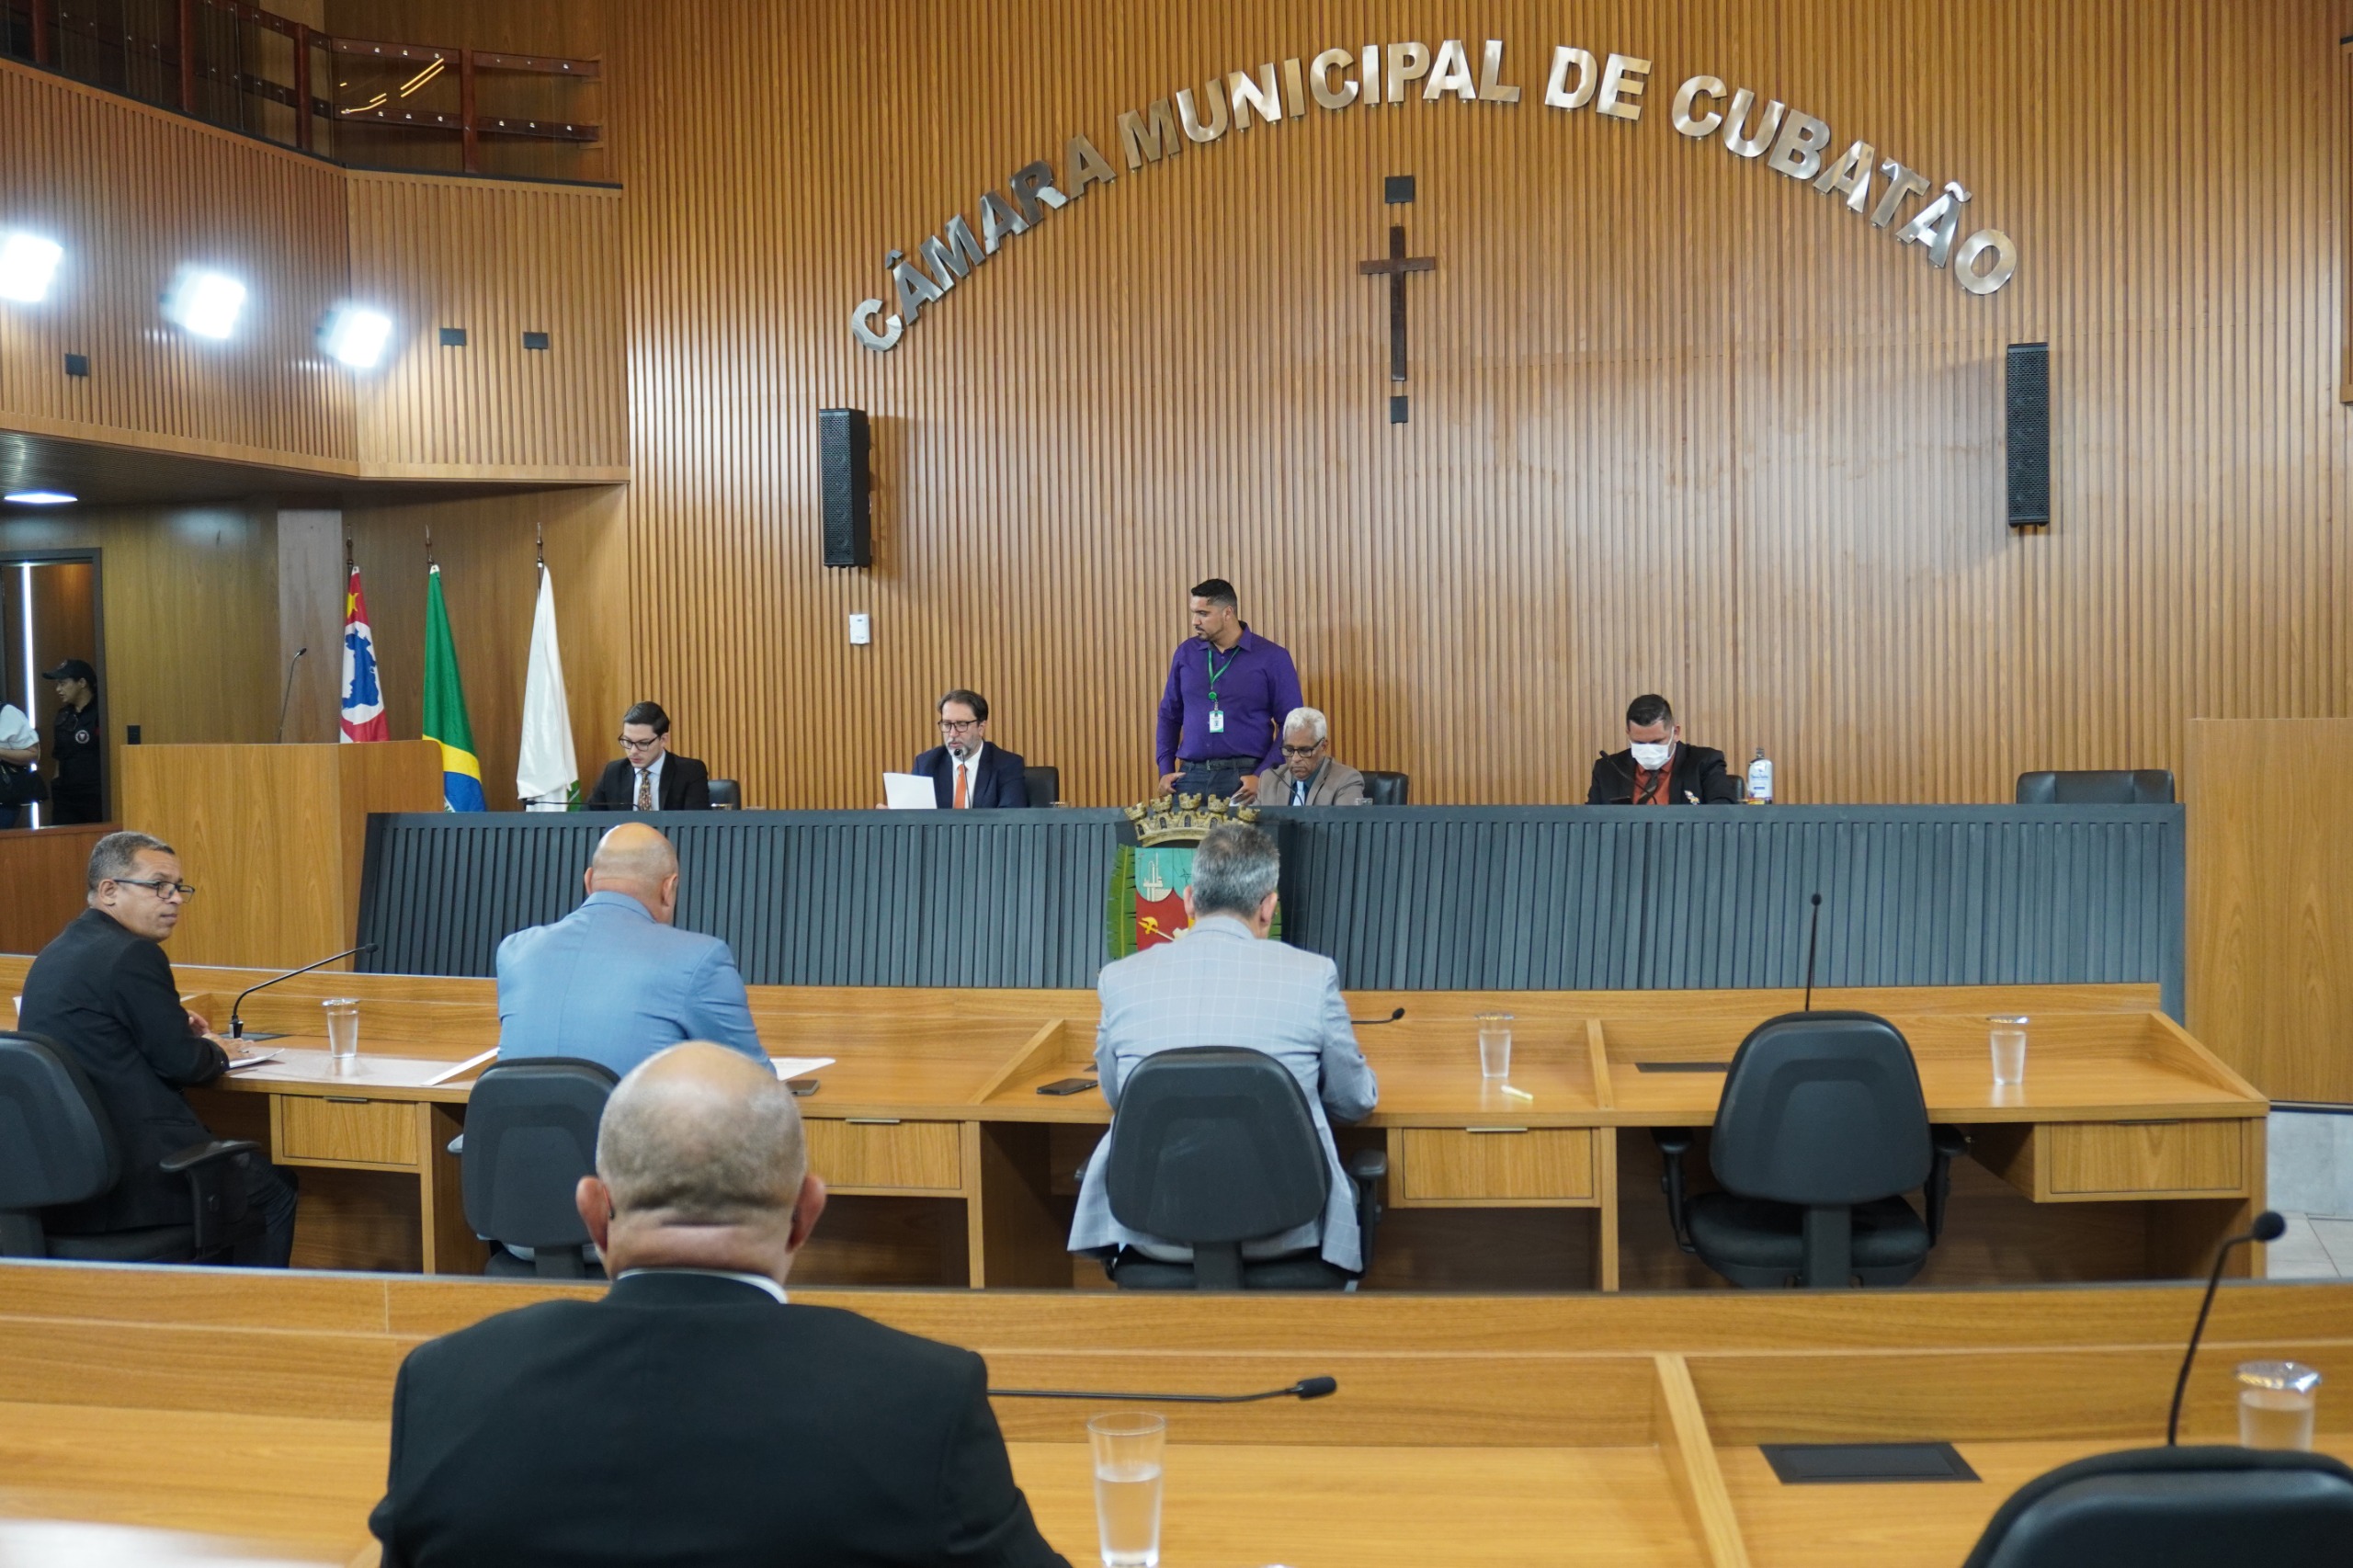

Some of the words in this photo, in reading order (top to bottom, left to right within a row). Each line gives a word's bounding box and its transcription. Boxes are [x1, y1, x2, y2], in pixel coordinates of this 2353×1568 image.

[851, 134, 1116, 351] CÂMARA
[1117, 40, 1520, 169] MUNICIPAL
[1545, 45, 1652, 120] DE
[1671, 74, 2018, 295] CUBATÃO
